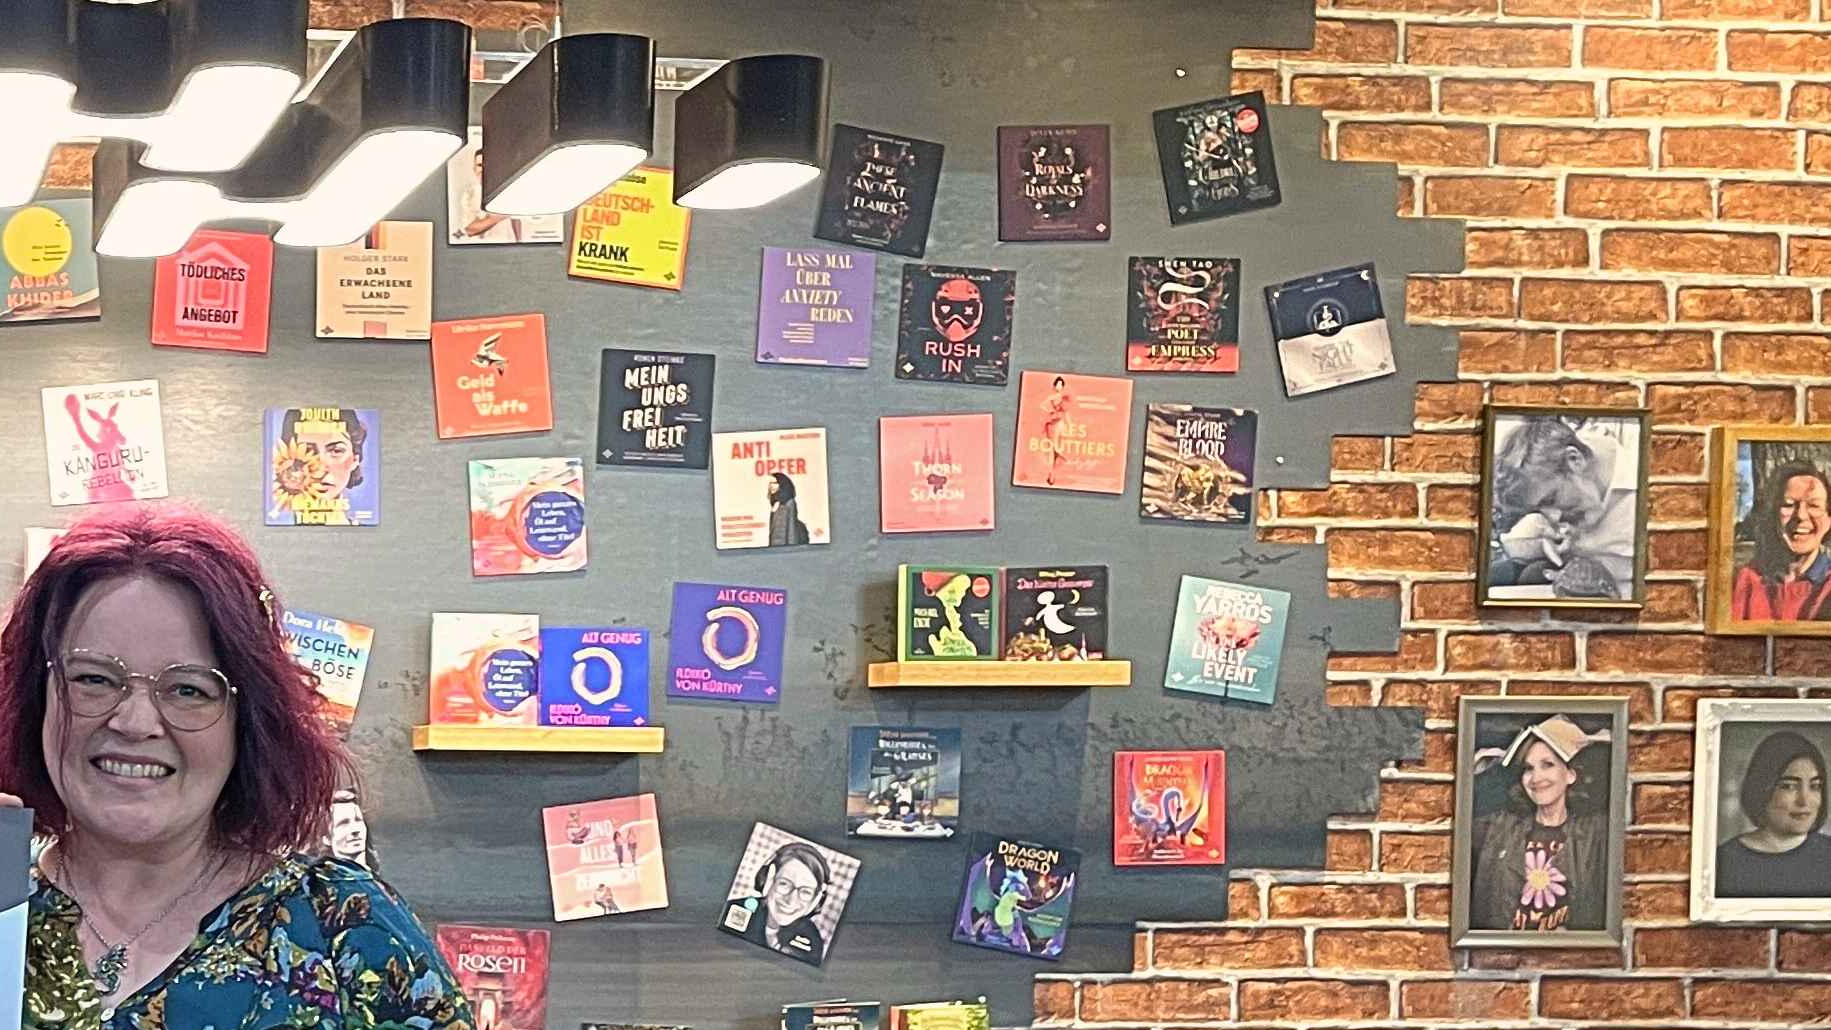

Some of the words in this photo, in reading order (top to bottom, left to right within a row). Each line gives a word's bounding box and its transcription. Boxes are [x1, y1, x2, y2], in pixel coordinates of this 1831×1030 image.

[1025, 184, 1083, 198] DARKNESS
[587, 194, 655, 214] EUTSCH-
[582, 207, 621, 227] LAND
[580, 225, 604, 241] IST
[577, 240, 630, 263] KRANK
[785, 252, 821, 268] LASS
[824, 253, 854, 269] MAL
[180, 262, 247, 282] TÖDLICHES
[365, 266, 387, 276] DAS
[361, 290, 391, 300] LAND
[780, 288, 843, 305] ANXIETY
[181, 306, 240, 324] ANGEBOT
[810, 306, 854, 323] REDEN
[923, 340, 982, 359] RUSH
[940, 358, 963, 374] IN
[456, 372, 496, 391] Geld
[624, 364, 672, 390] MEIN
[641, 383, 691, 407] UNGS
[473, 399, 529, 417] Waffe
[621, 407, 664, 432] FREI
[645, 425, 687, 450] HEIT
[1029, 436, 1116, 457] BOUTTIERS
[731, 440, 772, 460] ANTI
[754, 457, 808, 477] OPFER
[717, 590, 737, 602] ALT
[738, 590, 784, 605] GENUG
[1192, 594, 1273, 624] YARROS
[1191, 641, 1248, 667] LIKELY
[312, 658, 357, 680] BÖSE
[1203, 661, 1258, 685] EVENT
[998, 840, 1060, 865] DRAGON
[1004, 854, 1052, 875] WORLD
